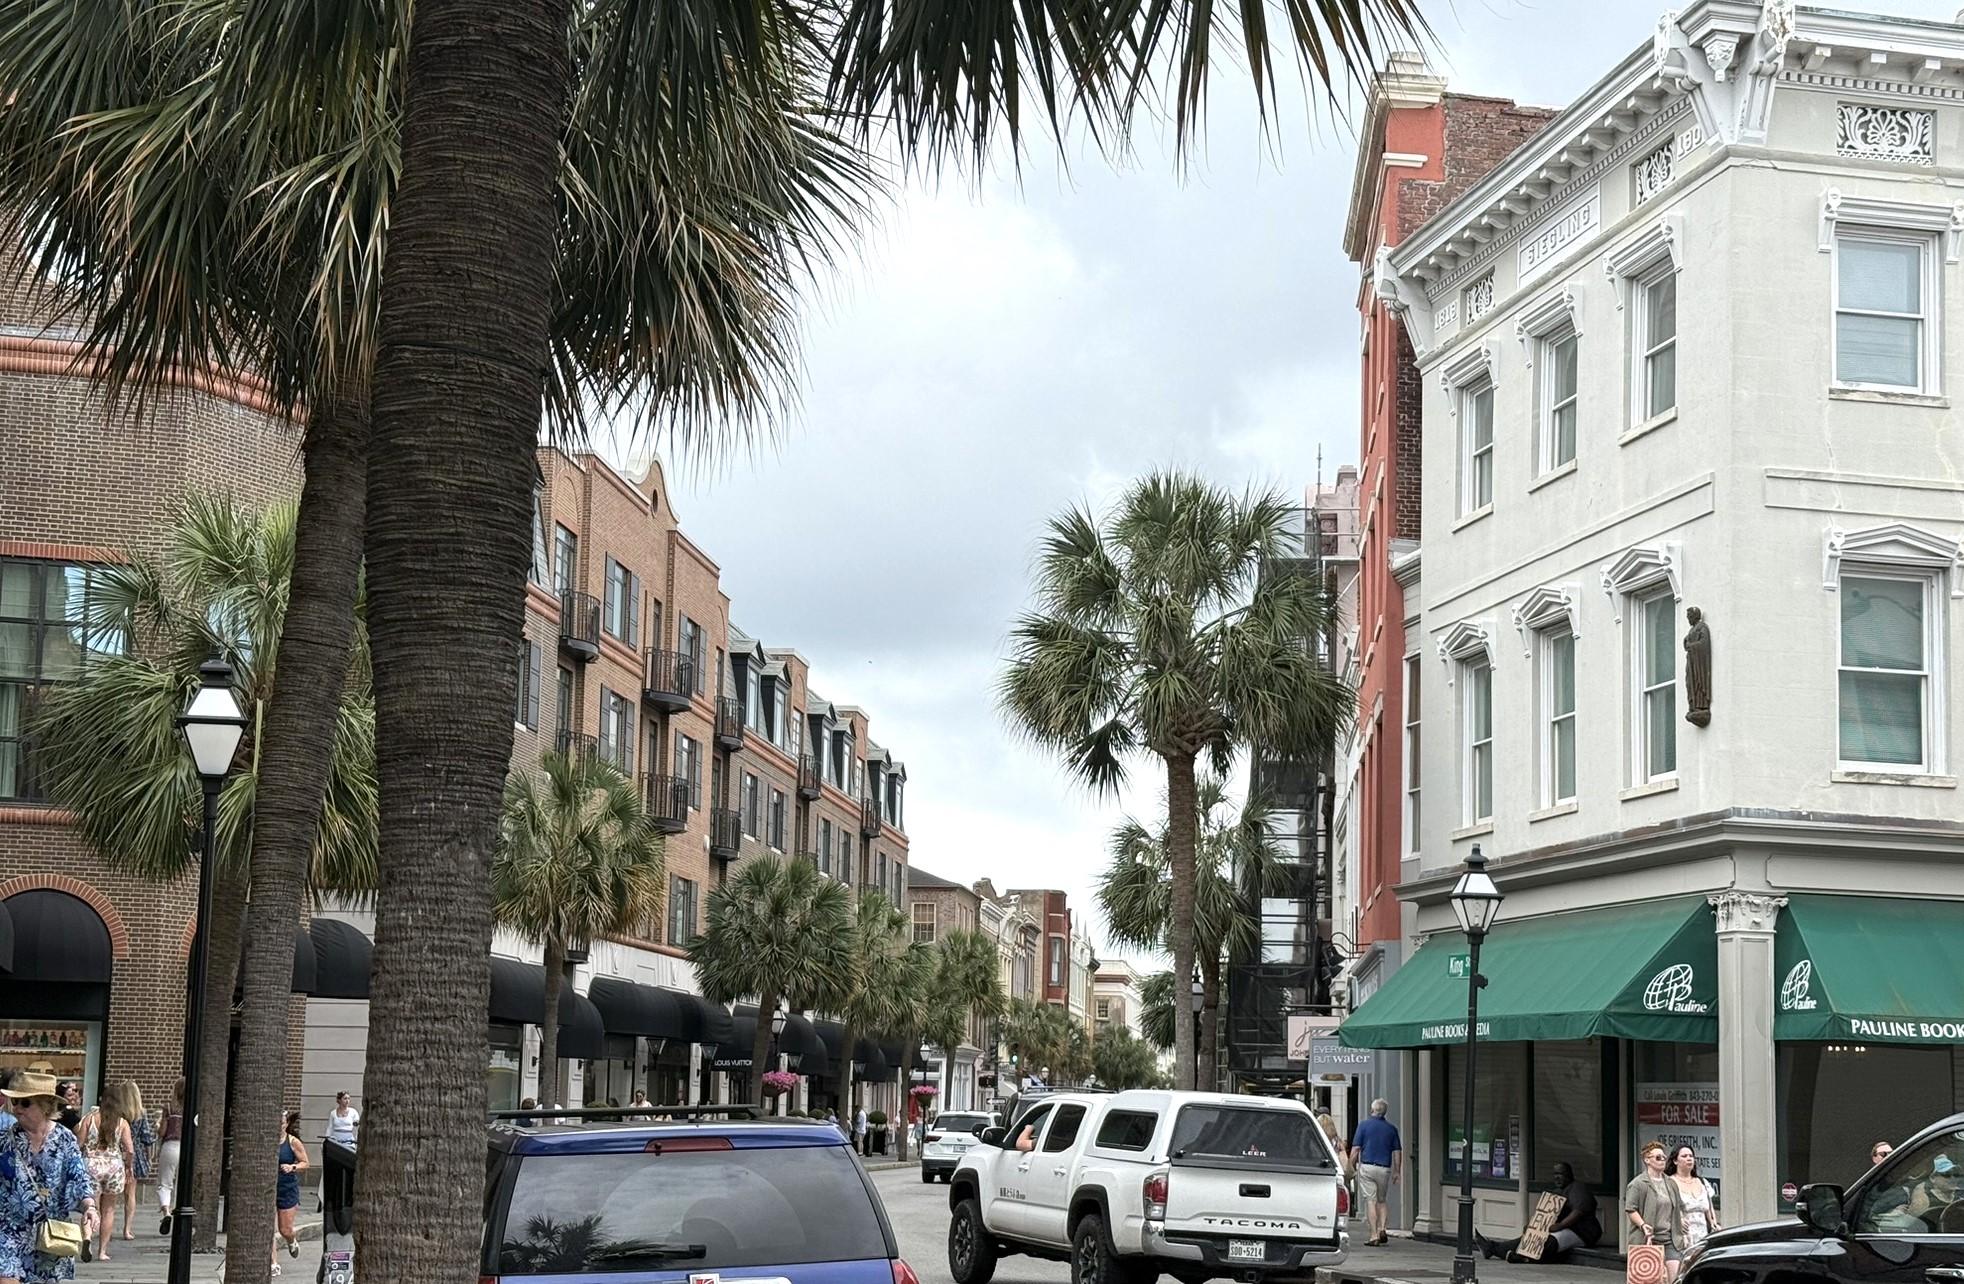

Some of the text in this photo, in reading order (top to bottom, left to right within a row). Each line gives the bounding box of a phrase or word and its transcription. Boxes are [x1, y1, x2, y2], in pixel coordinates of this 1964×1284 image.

[1528, 204, 1591, 265] SIEGLING
[1449, 956, 1471, 977] King S
[1421, 1025, 1445, 1040] PAULINE
[1445, 1023, 1465, 1038] BOOKS
[1476, 1022, 1490, 1036] EDIA
[1850, 1019, 1918, 1037] PAULINE
[1313, 1053, 1371, 1064] BUT water
[1660, 1104, 1709, 1124] FOR SALE
[1702, 1136, 1718, 1150] INC.
[1203, 1218, 1301, 1229] TACOMA
